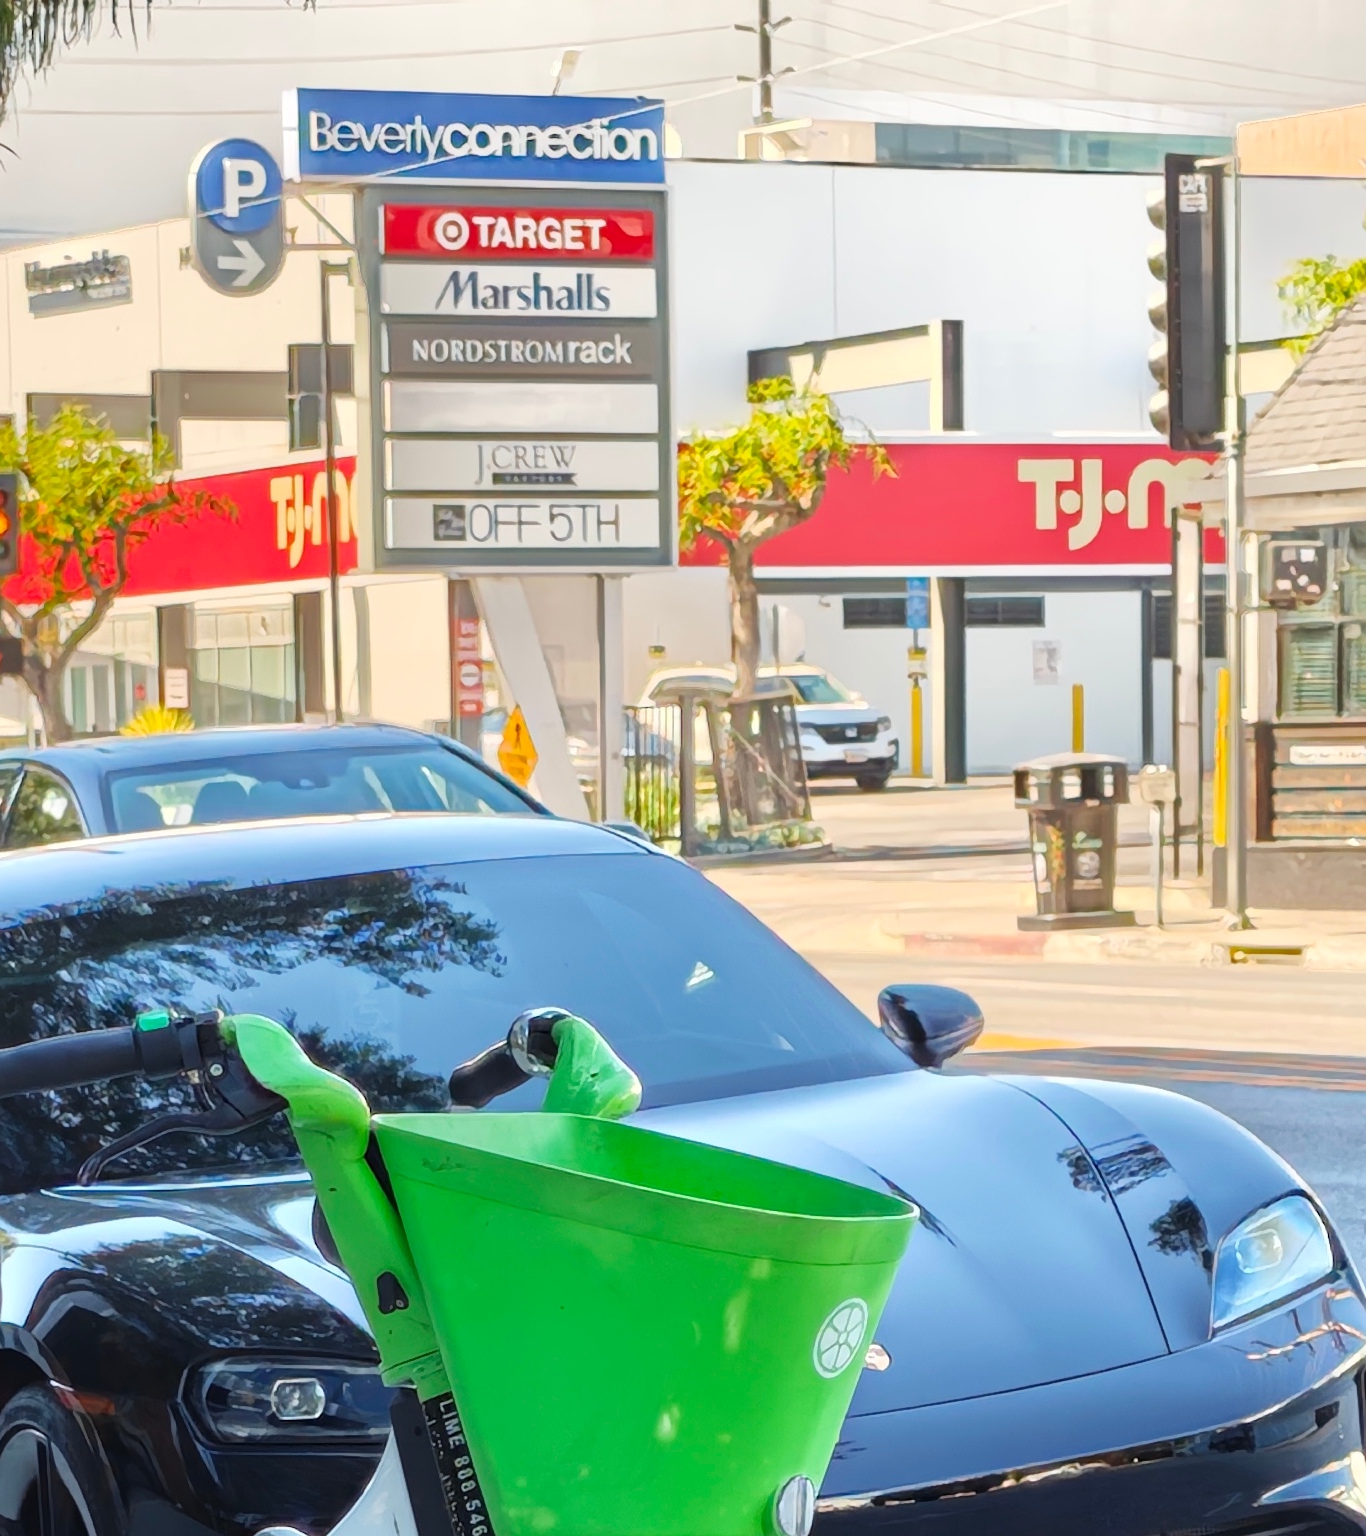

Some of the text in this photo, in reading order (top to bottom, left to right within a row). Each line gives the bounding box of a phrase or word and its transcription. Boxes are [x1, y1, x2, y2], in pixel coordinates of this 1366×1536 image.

[222, 158, 267, 218] P
[472, 216, 606, 250] TARGET
[435, 270, 611, 312] Marshalls
[469, 504, 620, 542] OFF 5TH
[439, 1399, 465, 1448] LIME
